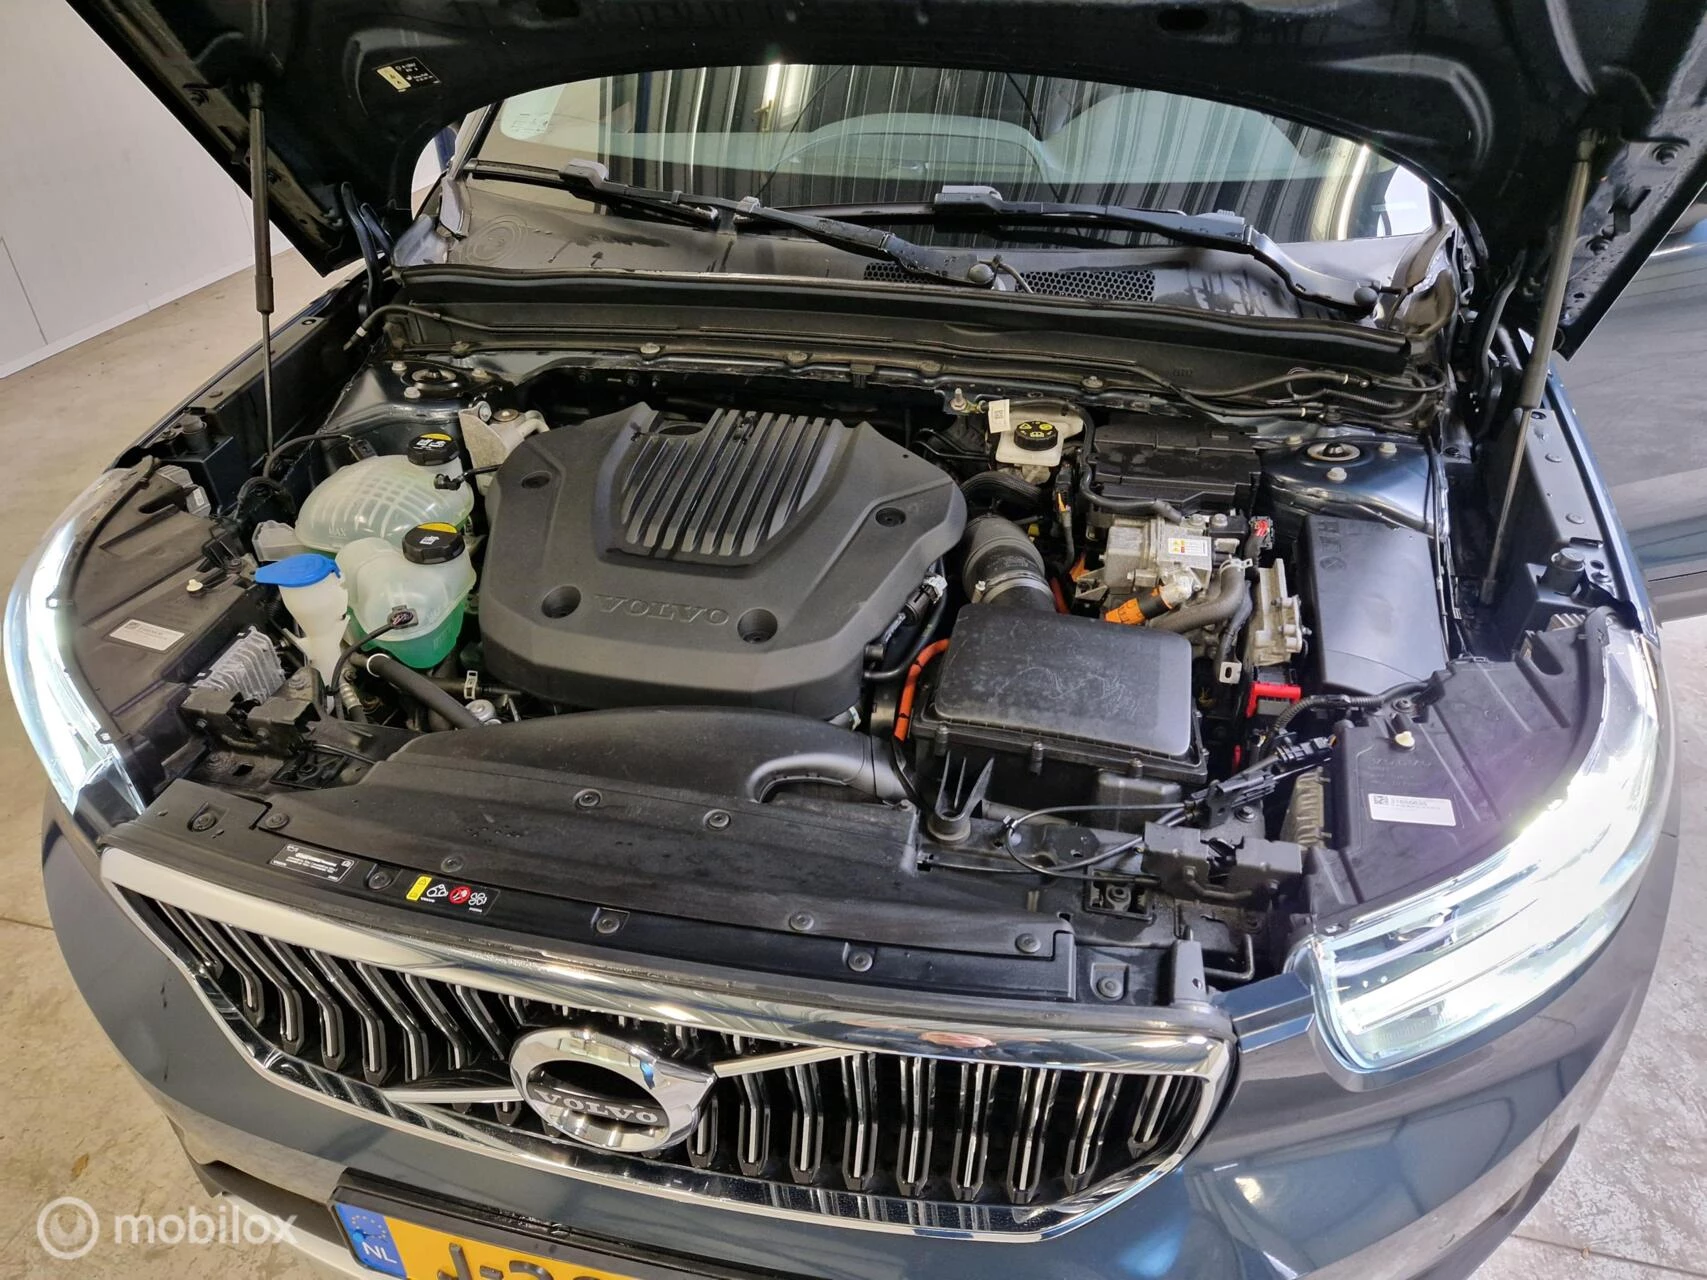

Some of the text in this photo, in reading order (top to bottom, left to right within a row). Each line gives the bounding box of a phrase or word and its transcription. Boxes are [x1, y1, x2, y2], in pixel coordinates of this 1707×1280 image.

[328, 526, 347, 537] MAX
[594, 593, 730, 626] VOLVO
[534, 1088, 658, 1124] VOLVO
[361, 1240, 398, 1265] NL
